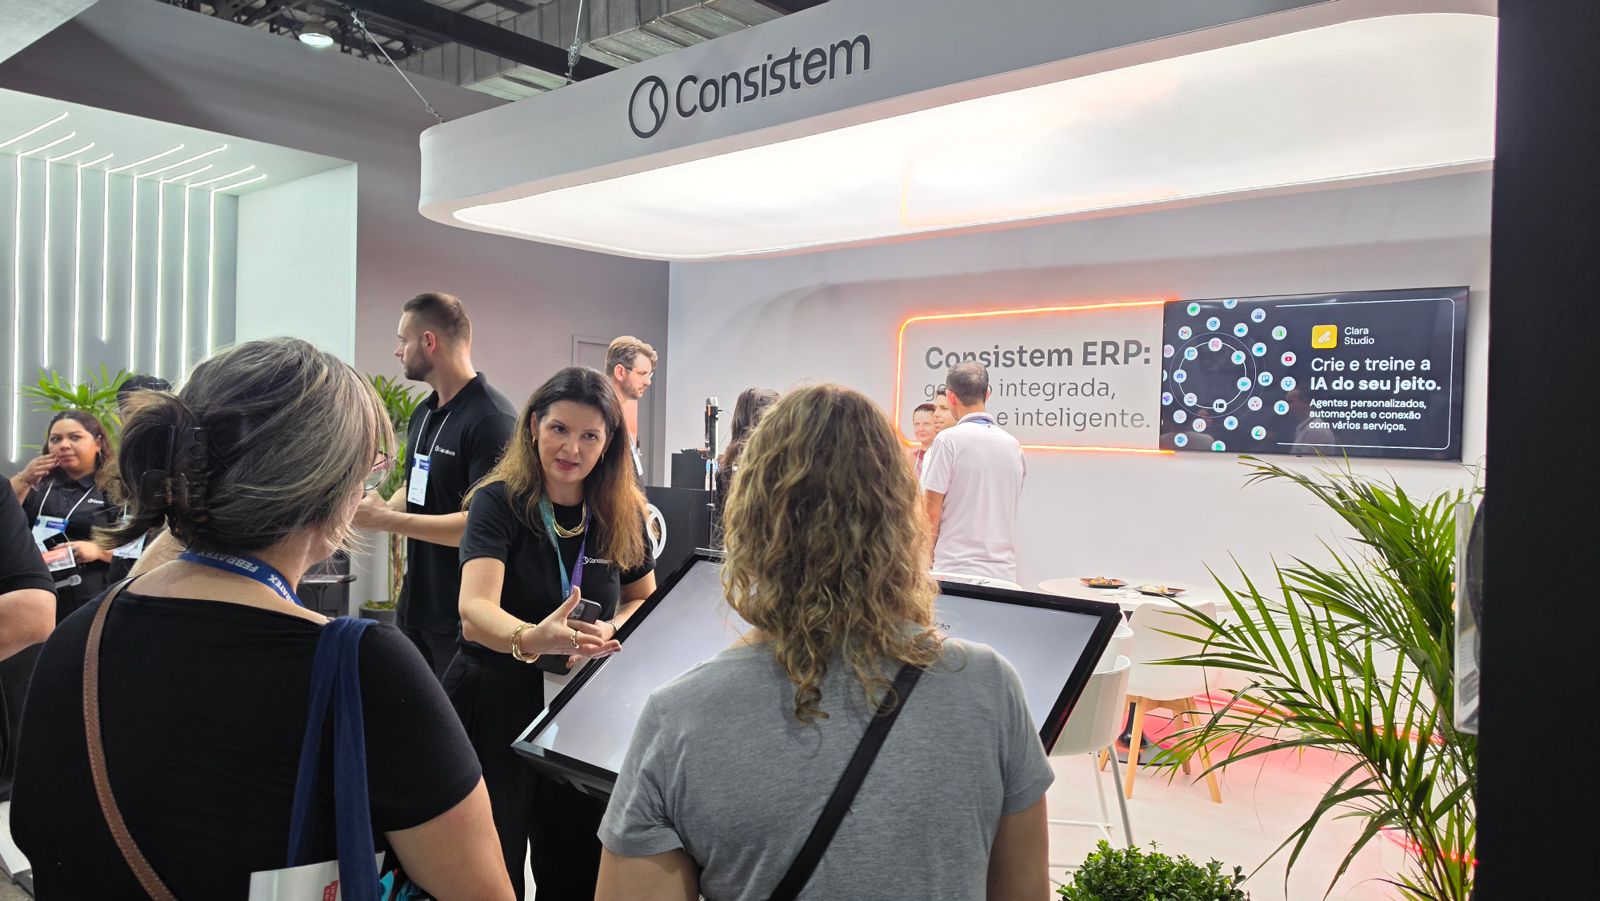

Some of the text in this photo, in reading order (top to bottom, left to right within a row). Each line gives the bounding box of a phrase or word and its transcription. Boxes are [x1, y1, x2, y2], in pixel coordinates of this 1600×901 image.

[675, 34, 871, 118] Consistem
[1344, 326, 1369, 335] Clara
[1344, 336, 1375, 345] Studio
[1082, 339, 1151, 366] ERP:
[1311, 356, 1431, 371] Crie e treine a
[999, 378, 1116, 401] integrada,
[1310, 376, 1441, 394] IA do seu jeito.
[1309, 398, 1427, 409] Agentes personalizados,
[996, 407, 1151, 431] e inteligente.
[1309, 410, 1421, 421] automações e conexão
[1309, 420, 1407, 433] com vários serviços.
